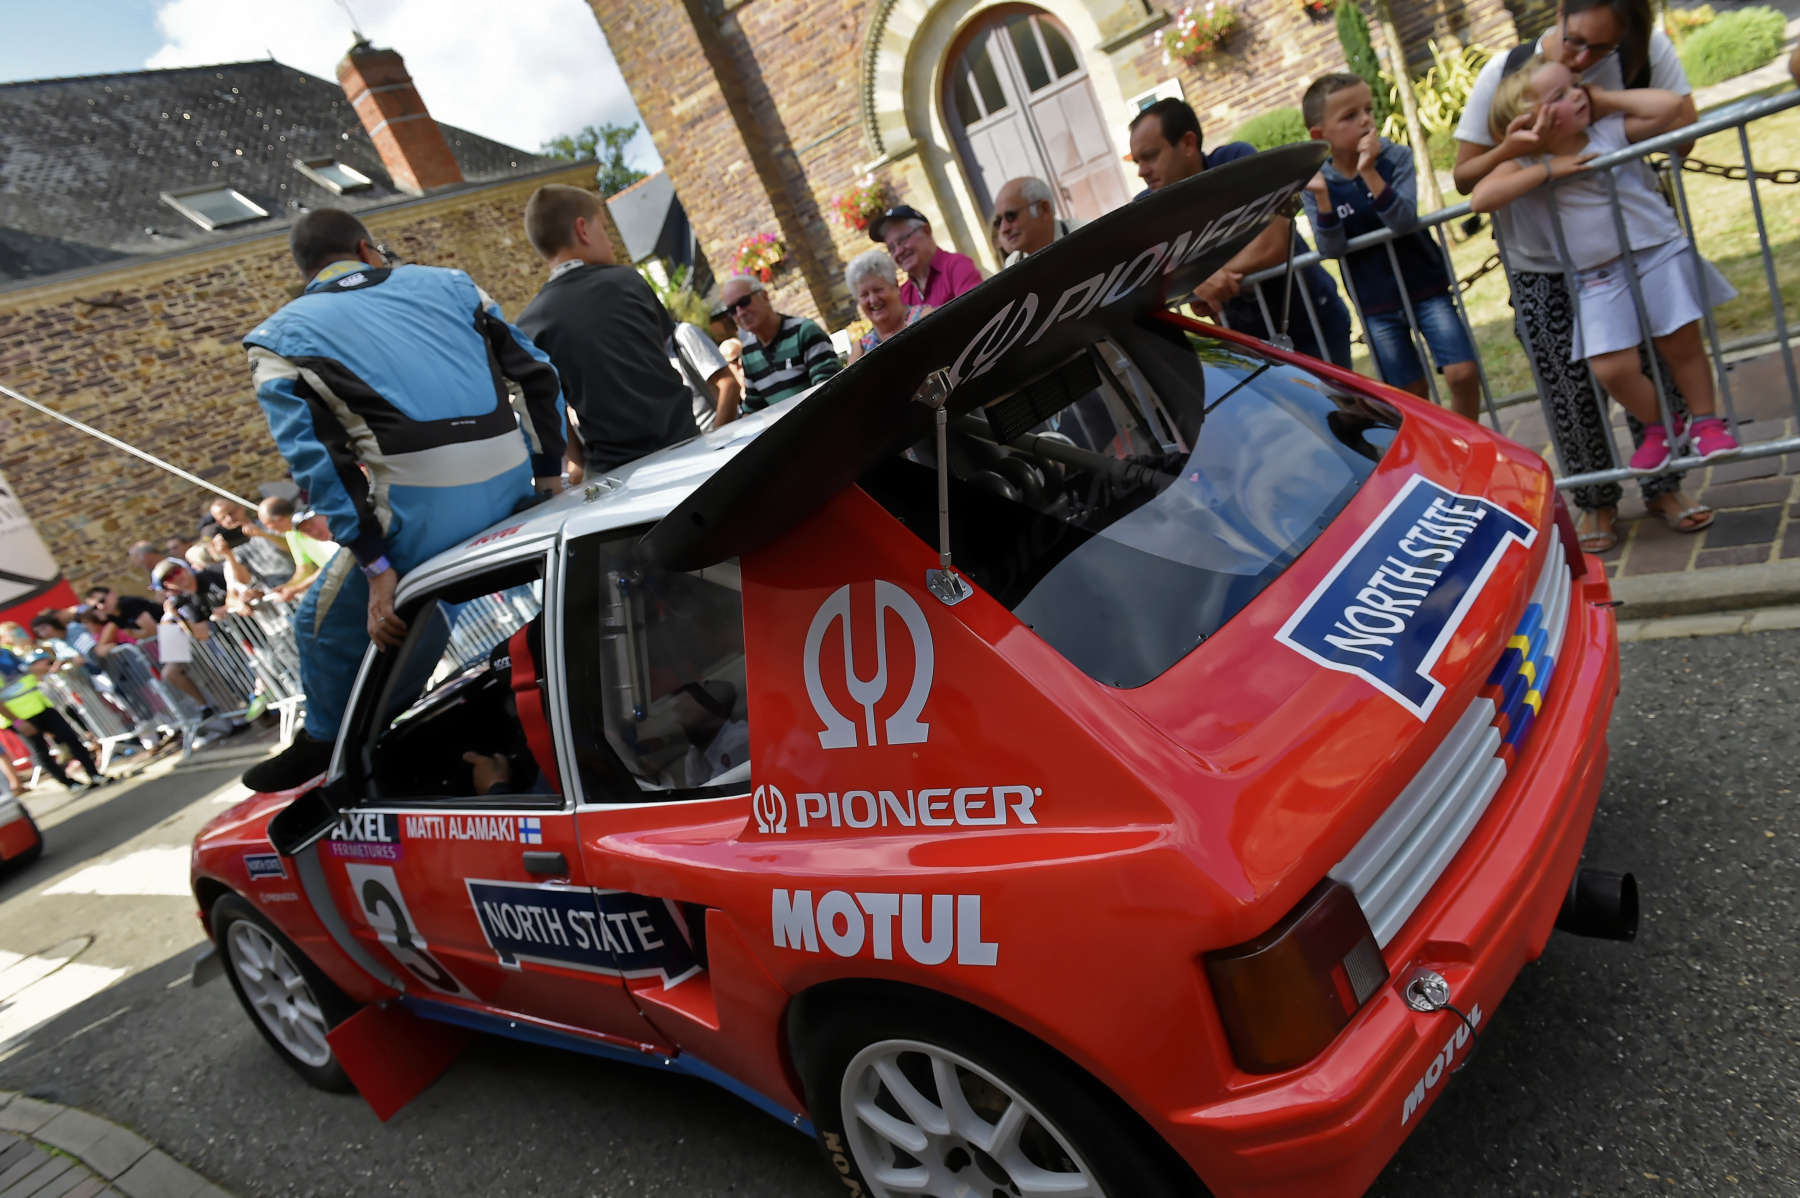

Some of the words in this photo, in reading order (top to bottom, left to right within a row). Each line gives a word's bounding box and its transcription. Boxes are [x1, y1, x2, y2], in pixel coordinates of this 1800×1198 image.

[1323, 555, 1443, 662] NORTH
[1397, 497, 1487, 564] STATE
[331, 813, 392, 842] AXEL
[406, 816, 446, 840] MATTI
[449, 817, 516, 842] ALAMAKI
[795, 785, 1039, 828] PIONEER
[331, 842, 397, 860] FERMETURES
[362, 878, 461, 993] 3
[482, 901, 570, 947] NORTH
[567, 908, 665, 954] STATE
[771, 888, 999, 966] MOTUL
[1401, 1003, 1482, 1126] MOTUL
